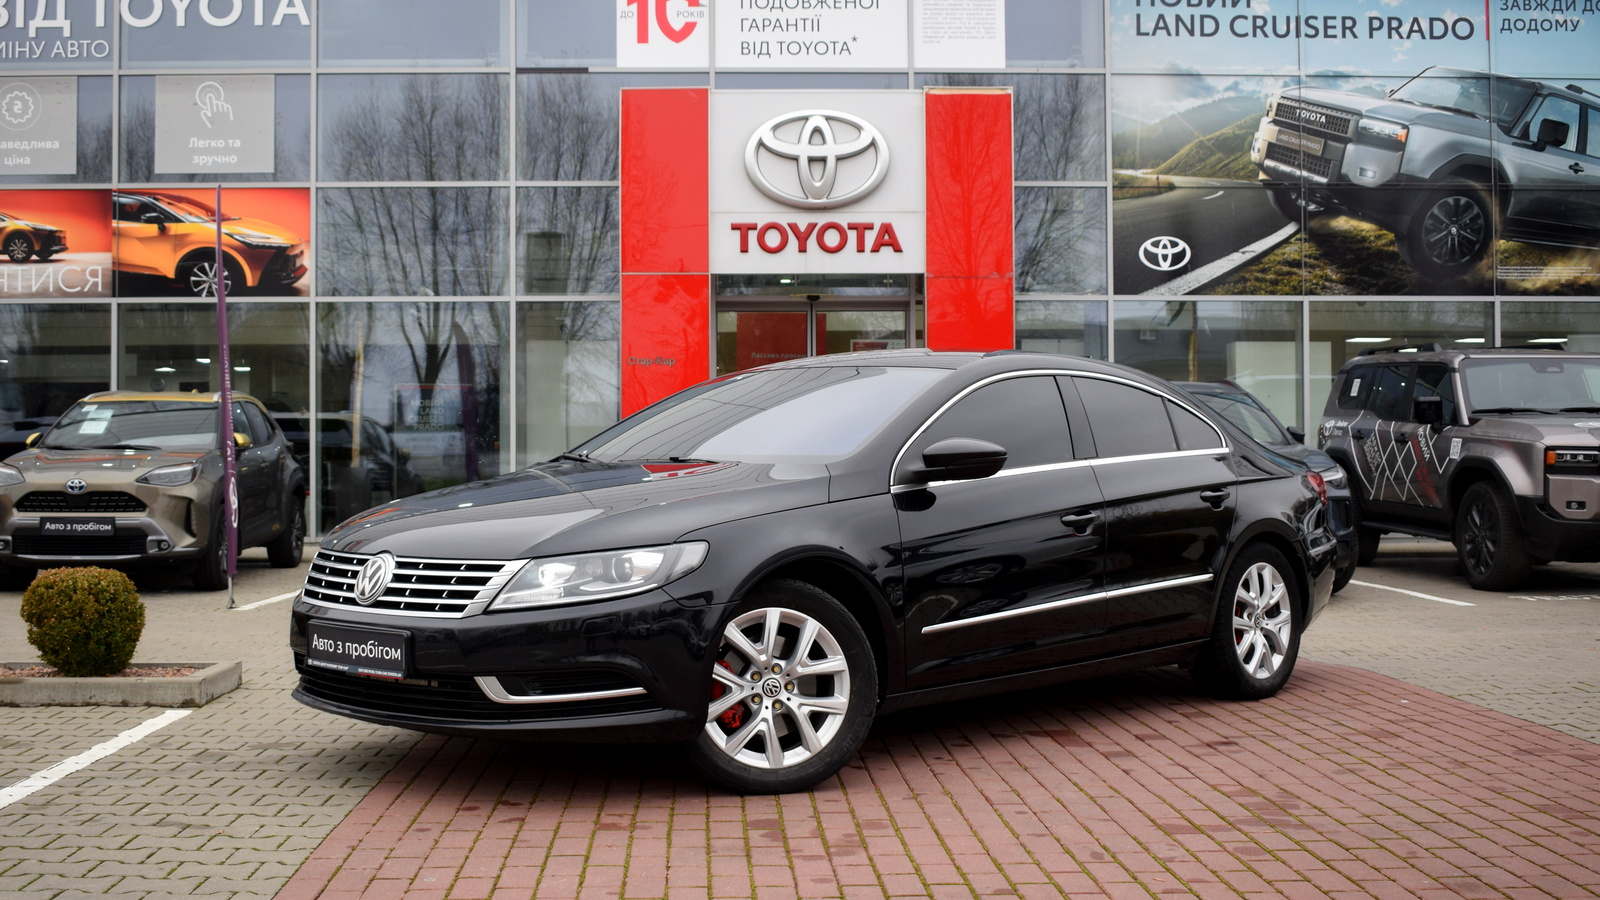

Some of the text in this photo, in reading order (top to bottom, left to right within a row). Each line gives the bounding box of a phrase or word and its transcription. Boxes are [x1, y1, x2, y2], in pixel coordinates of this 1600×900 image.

[676, 10, 705, 18] РОКІВ
[1500, 0, 1576, 14] ЗАВЖДИ
[620, 10, 634, 19] ДО
[740, 14, 822, 32] ГАРАНТІЇ
[1136, 13, 1475, 40] LAND CRUISER PRADO
[1500, 18, 1580, 34] ДОДОМУ
[51, 40, 109, 58] АВТО
[740, 41, 771, 58] ВІД
[1296, 109, 1326, 123] TOYOTA
[189, 137, 241, 148] Легко та
[4, 154, 31, 166] ціна
[192, 155, 237, 166] зручно
[731, 221, 903, 254] TOYOTA
[628, 356, 675, 367] Стар-Кар
[45, 522, 65, 530] Авто
[73, 522, 112, 531] пробігом
[312, 633, 401, 661] Авто з пробігом
